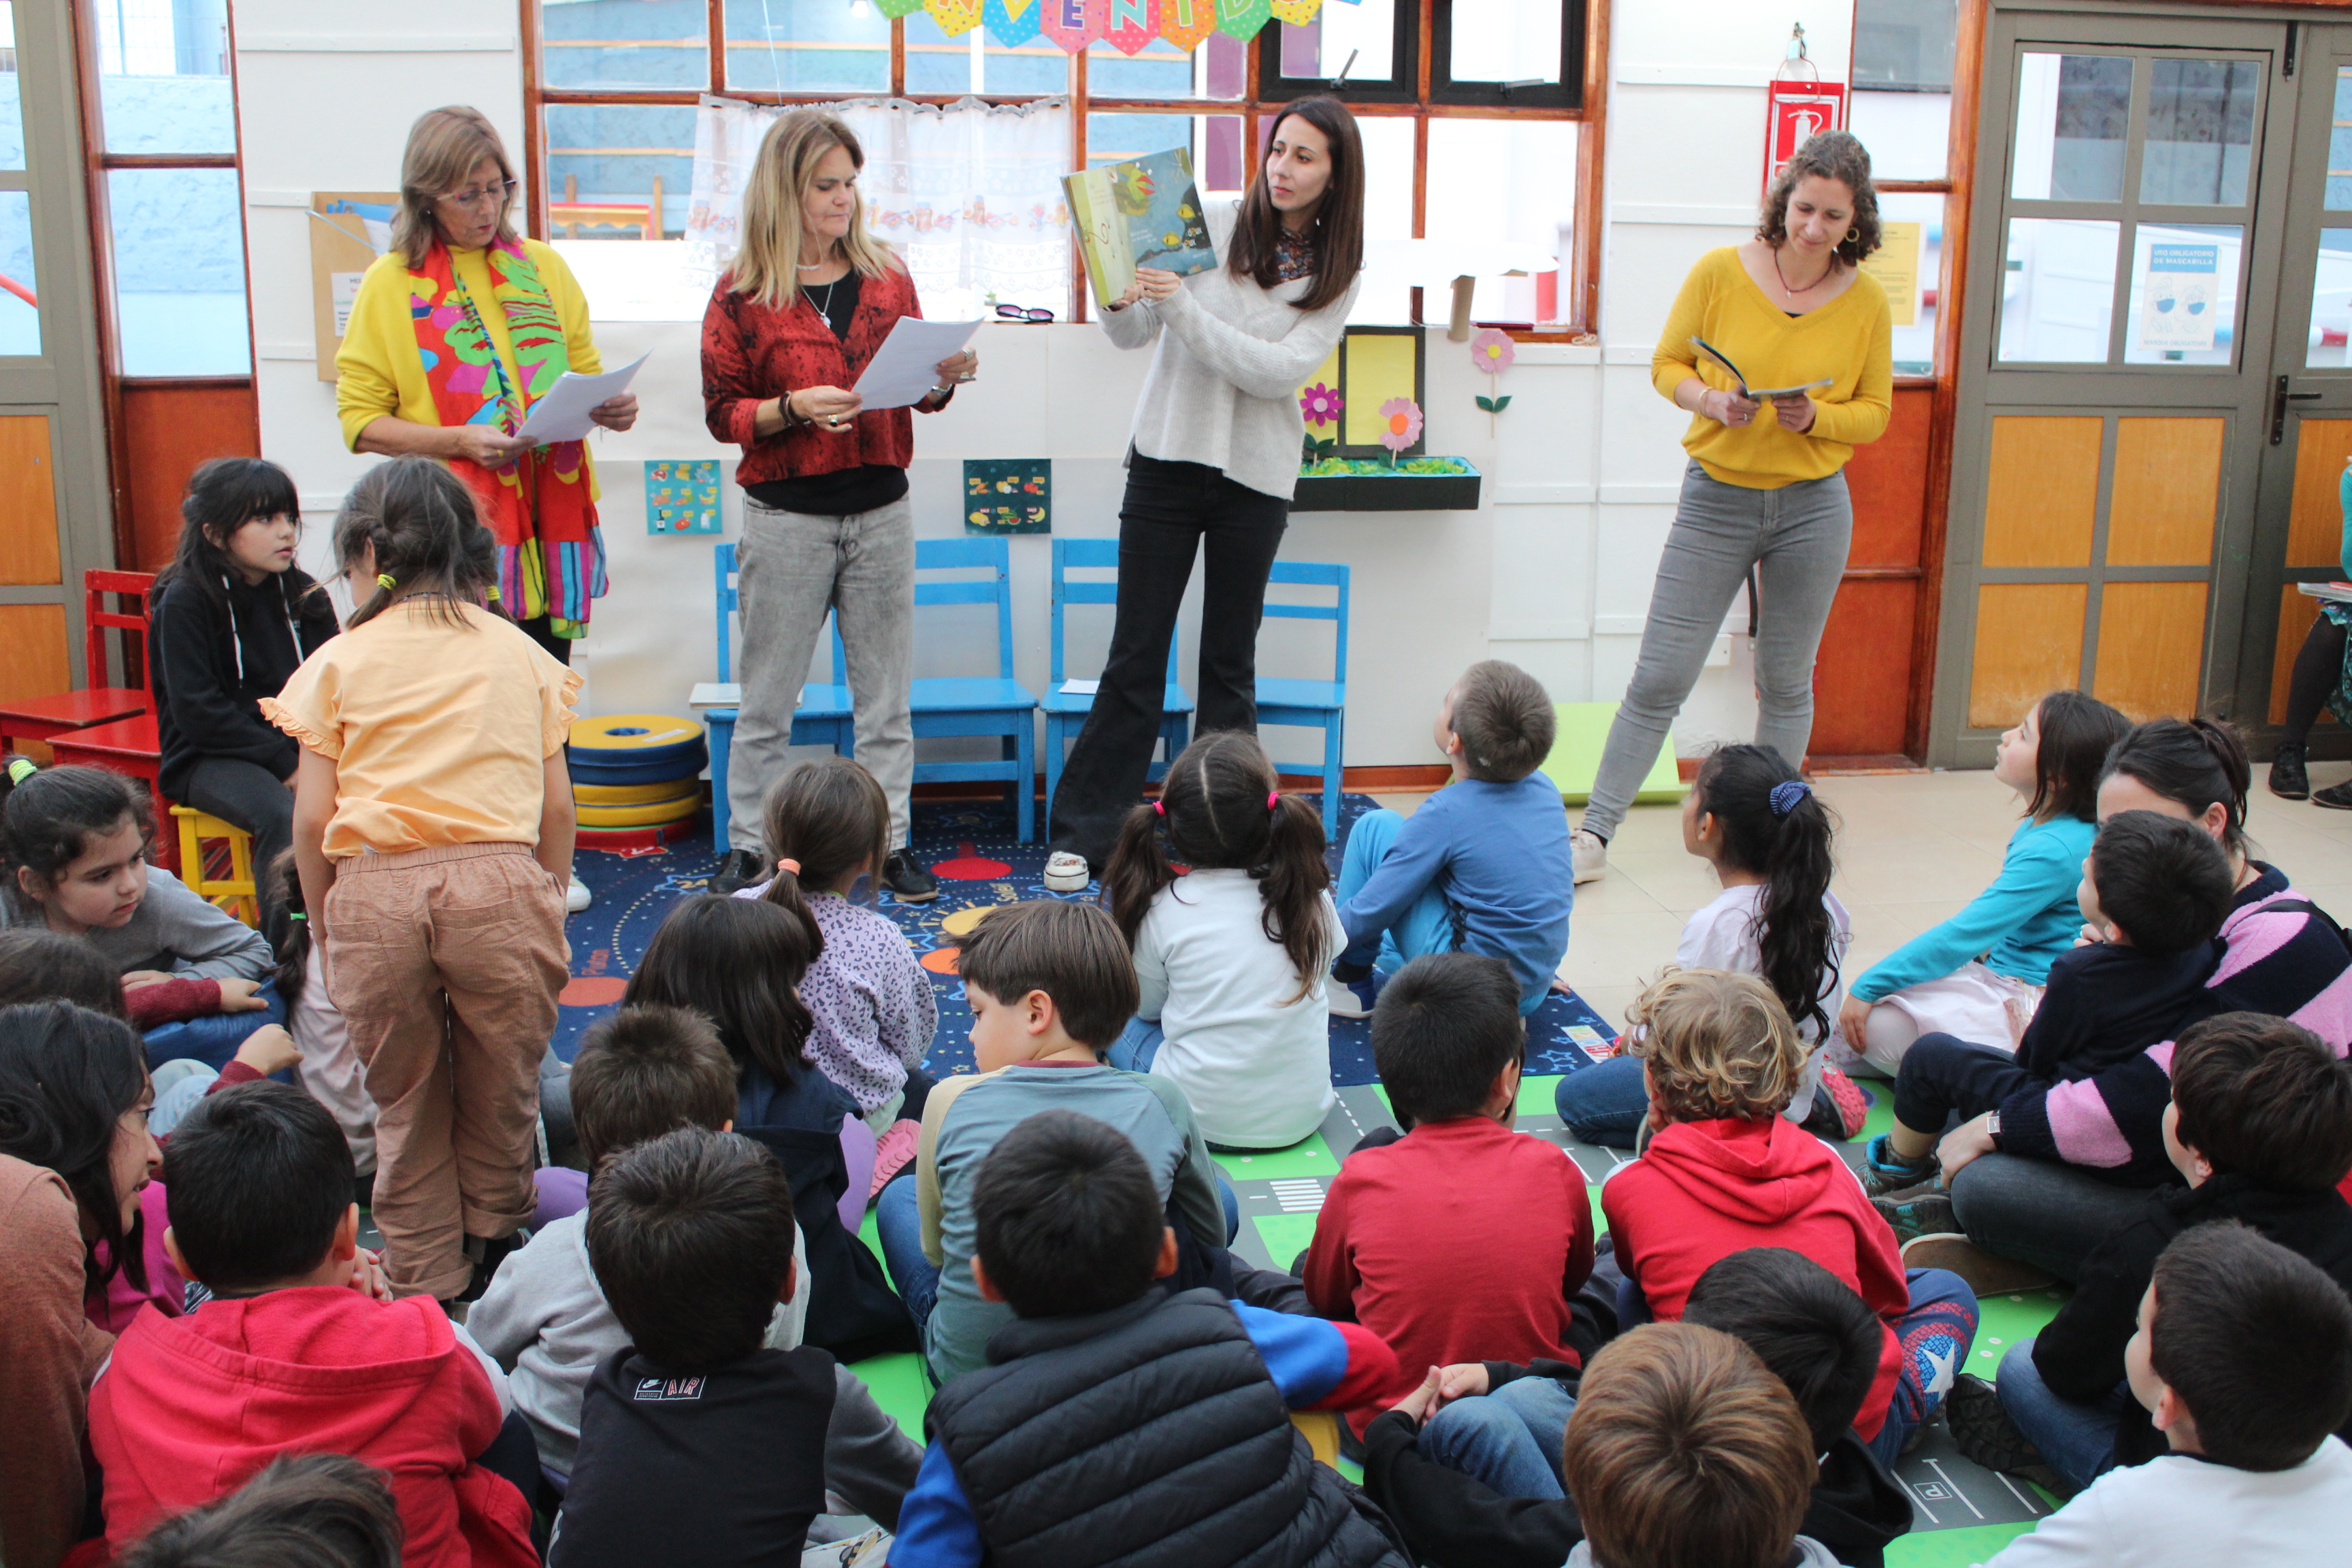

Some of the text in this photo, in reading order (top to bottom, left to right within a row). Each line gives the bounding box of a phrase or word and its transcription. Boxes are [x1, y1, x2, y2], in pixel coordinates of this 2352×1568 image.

[2170, 249, 2214, 257] OBLIGATORIO
[581, 949, 610, 975] Pluton
[668, 1377, 700, 1396] AIR
